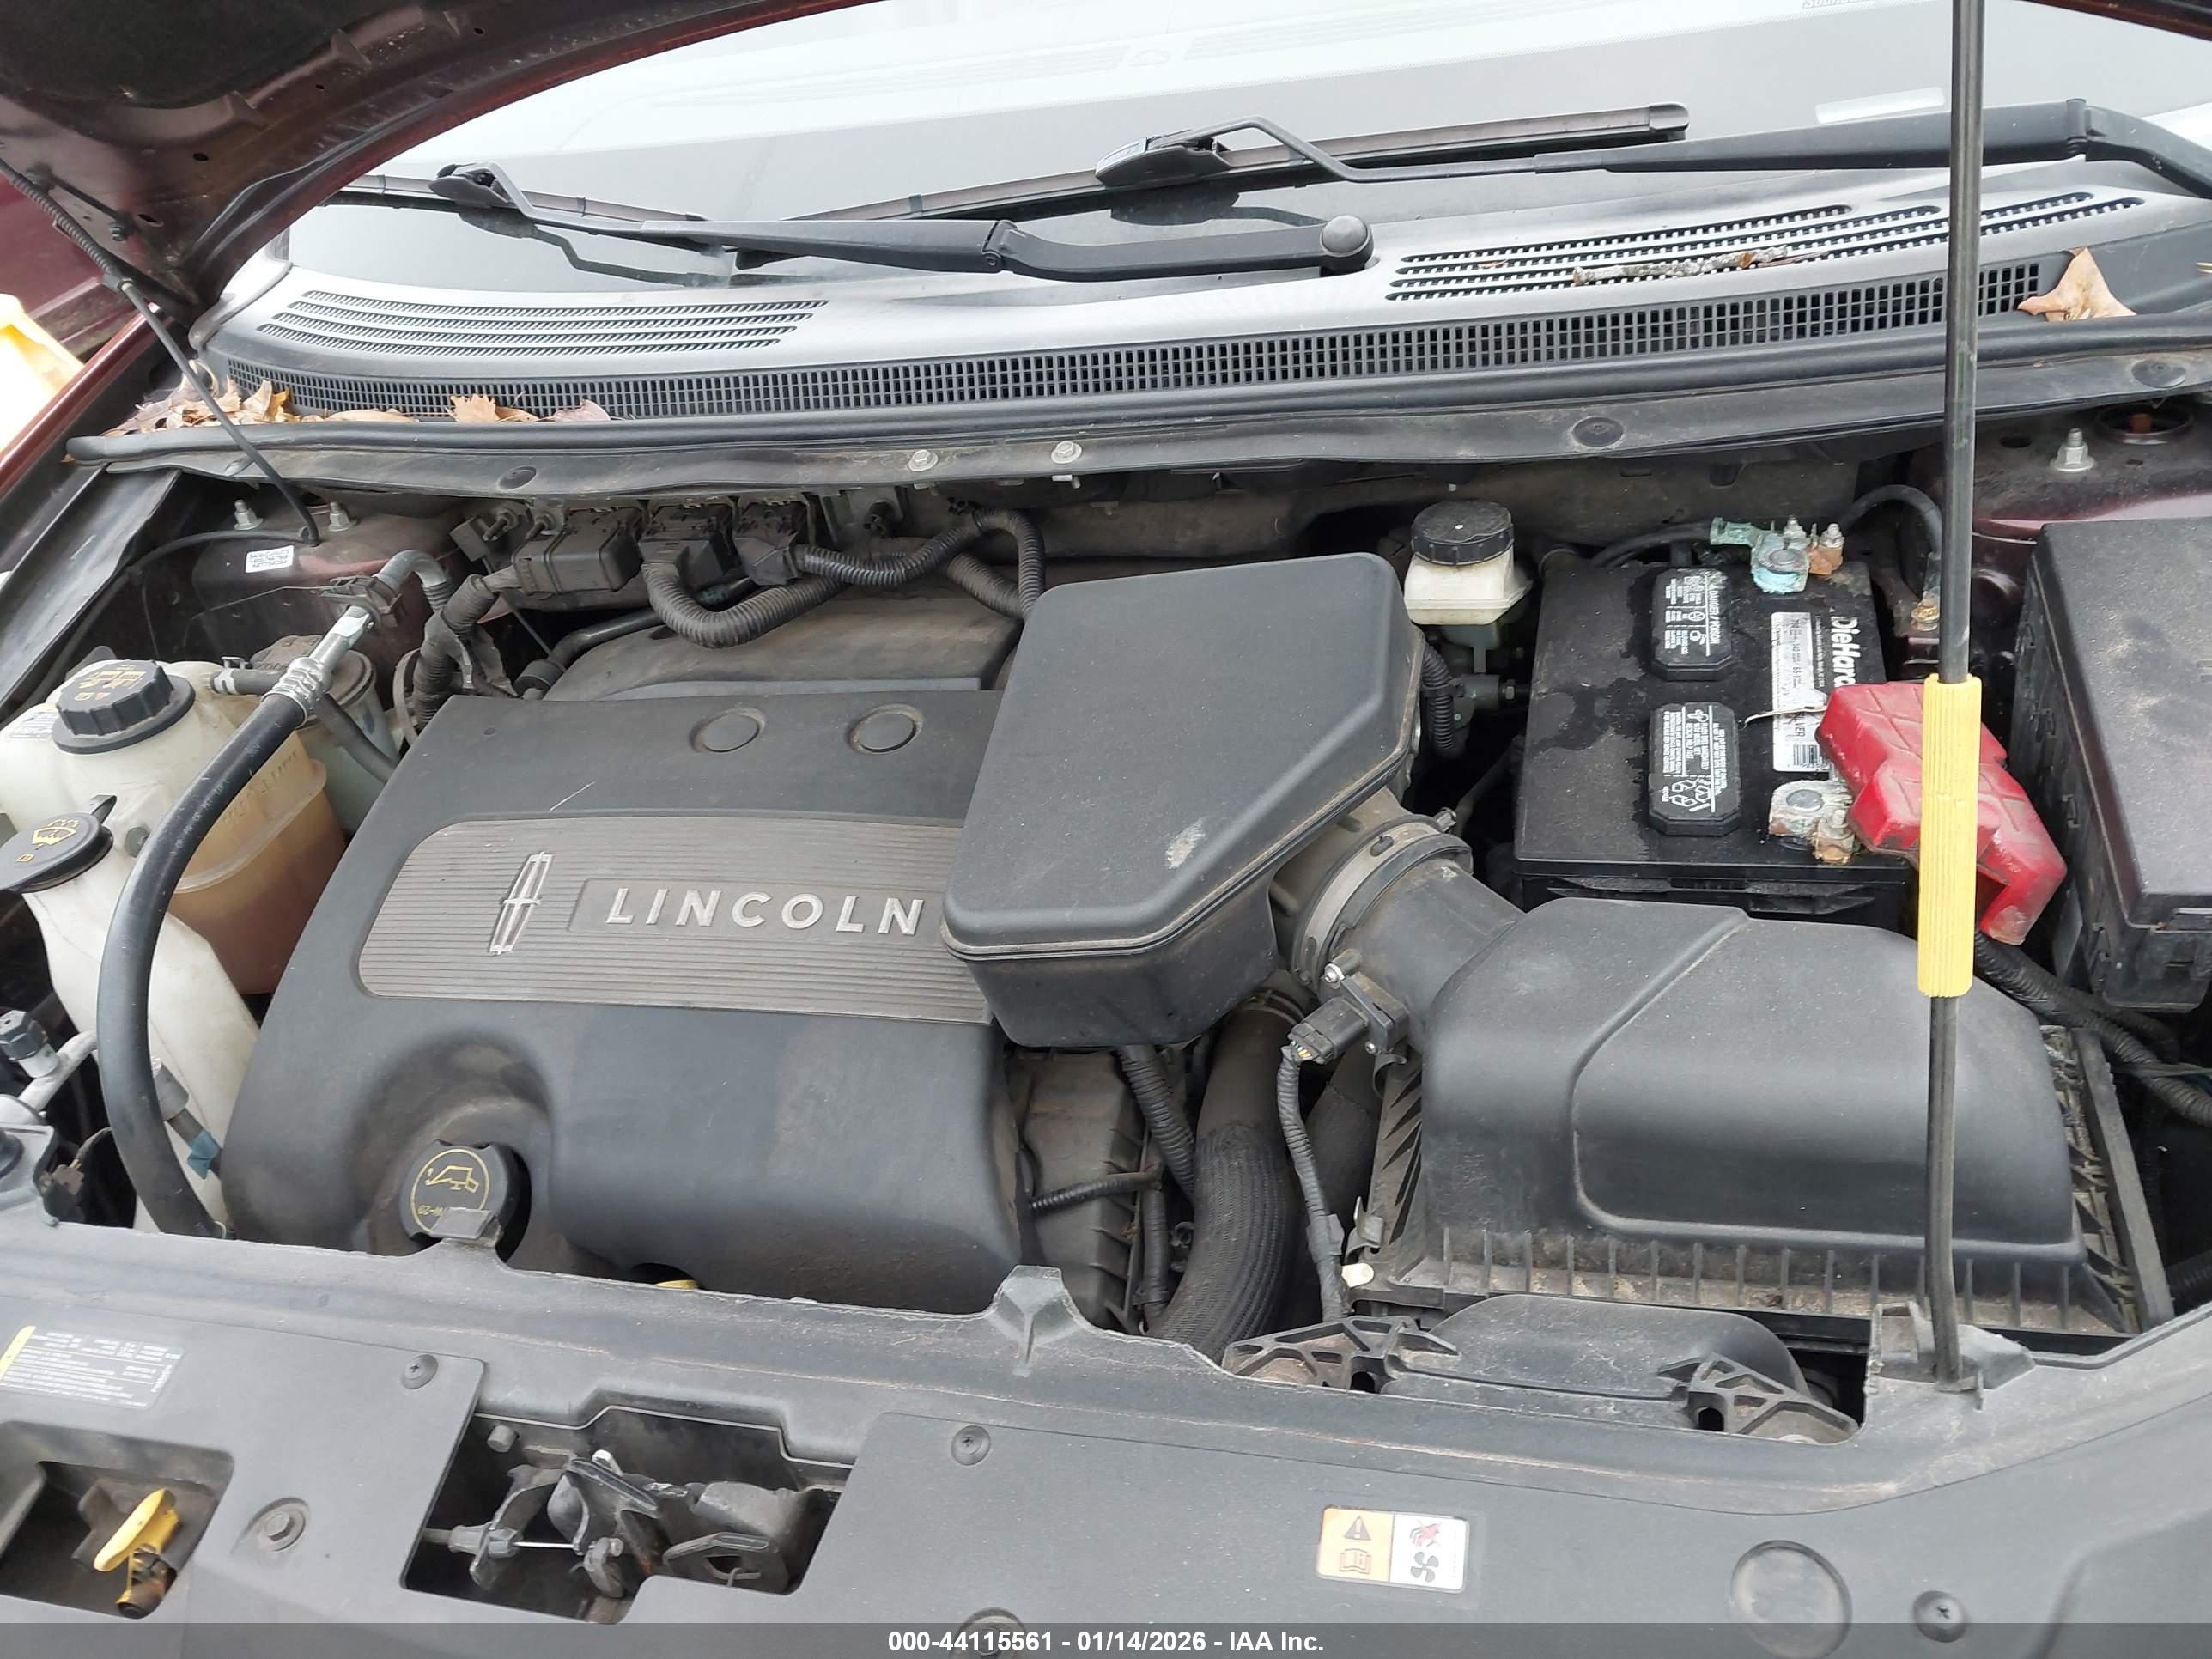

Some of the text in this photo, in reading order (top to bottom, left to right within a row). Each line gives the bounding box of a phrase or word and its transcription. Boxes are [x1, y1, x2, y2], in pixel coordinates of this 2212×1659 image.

[1709, 591, 1720, 615] DANGER
[1710, 621, 1721, 644] POISON
[605, 887, 924, 936] LINCOLN
